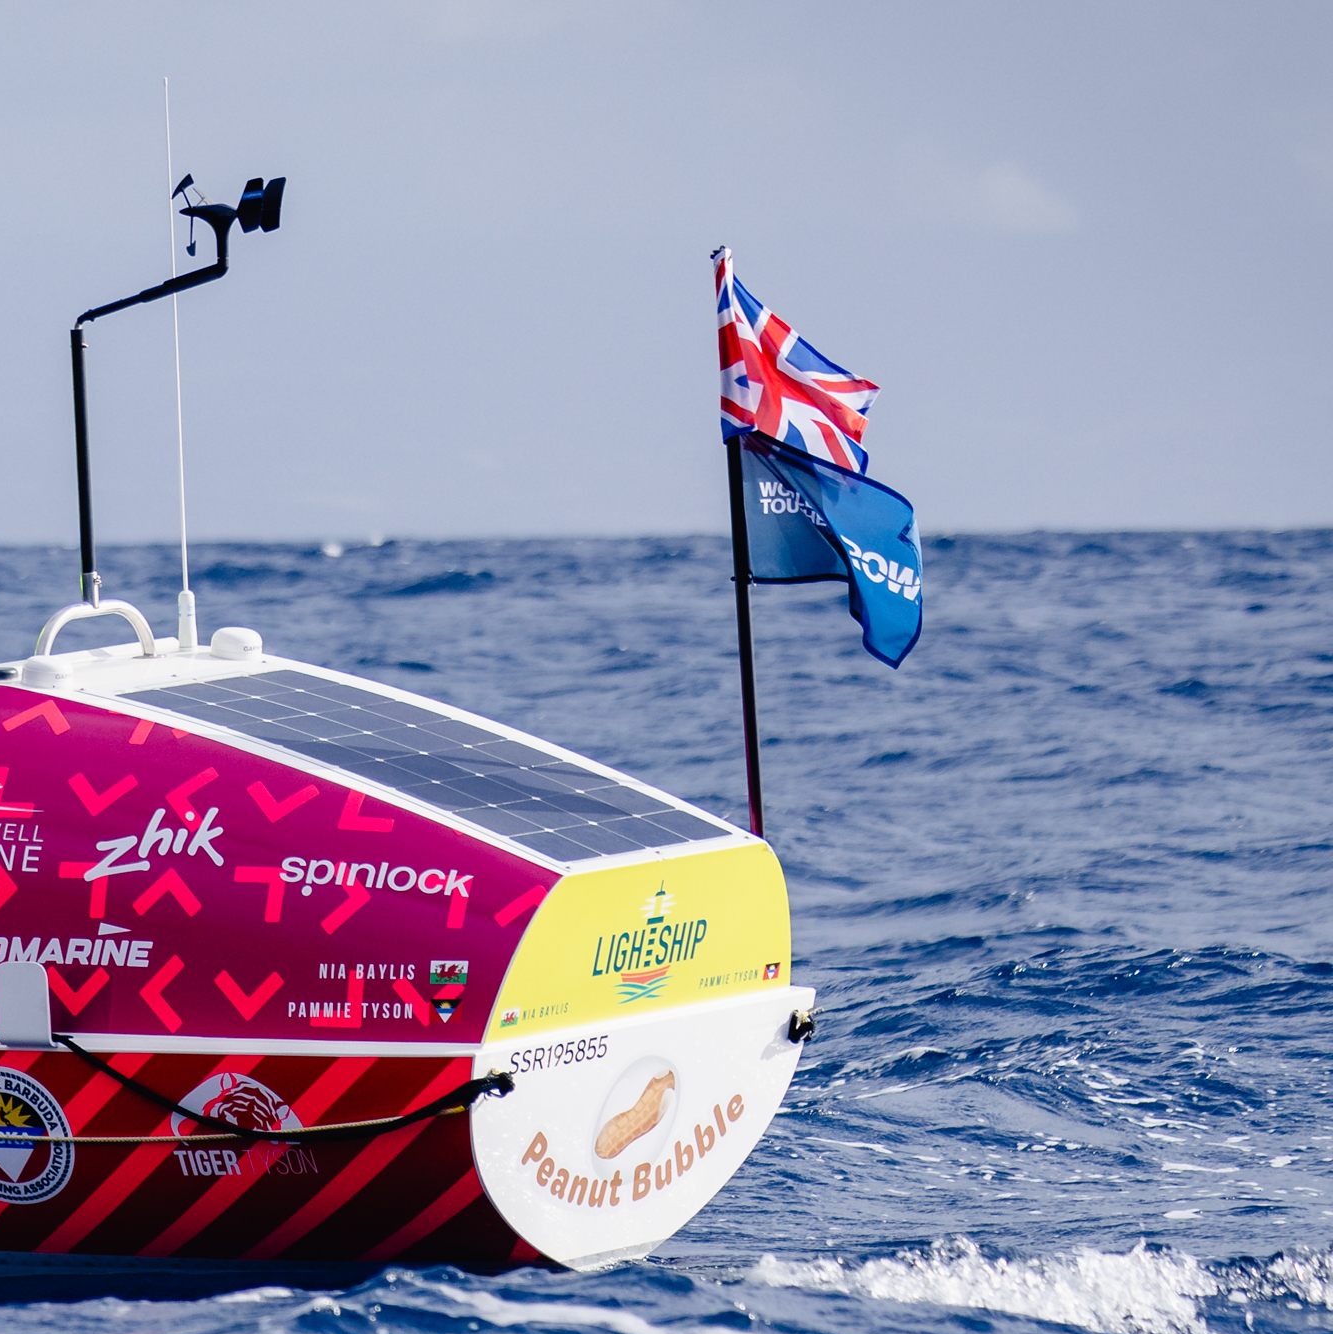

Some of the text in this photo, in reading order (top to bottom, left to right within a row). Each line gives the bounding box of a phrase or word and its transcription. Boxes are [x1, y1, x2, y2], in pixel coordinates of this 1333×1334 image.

[840, 534, 921, 601] ROW
[83, 807, 224, 881] zhik
[279, 856, 474, 897] spinlock
[319, 963, 416, 980] NIA BAYLIS
[699, 968, 760, 989] PAMMIE TYSON
[288, 1001, 414, 1019] PAMMIE TYSON
[521, 1001, 570, 1022] NIA BAYLIS
[510, 1034, 609, 1076] SSR195855
[4, 1079, 58, 1132] BARBUDA
[173, 1149, 319, 1176] TIGER TYSON
[521, 1093, 745, 1209] Peanut Bubble
